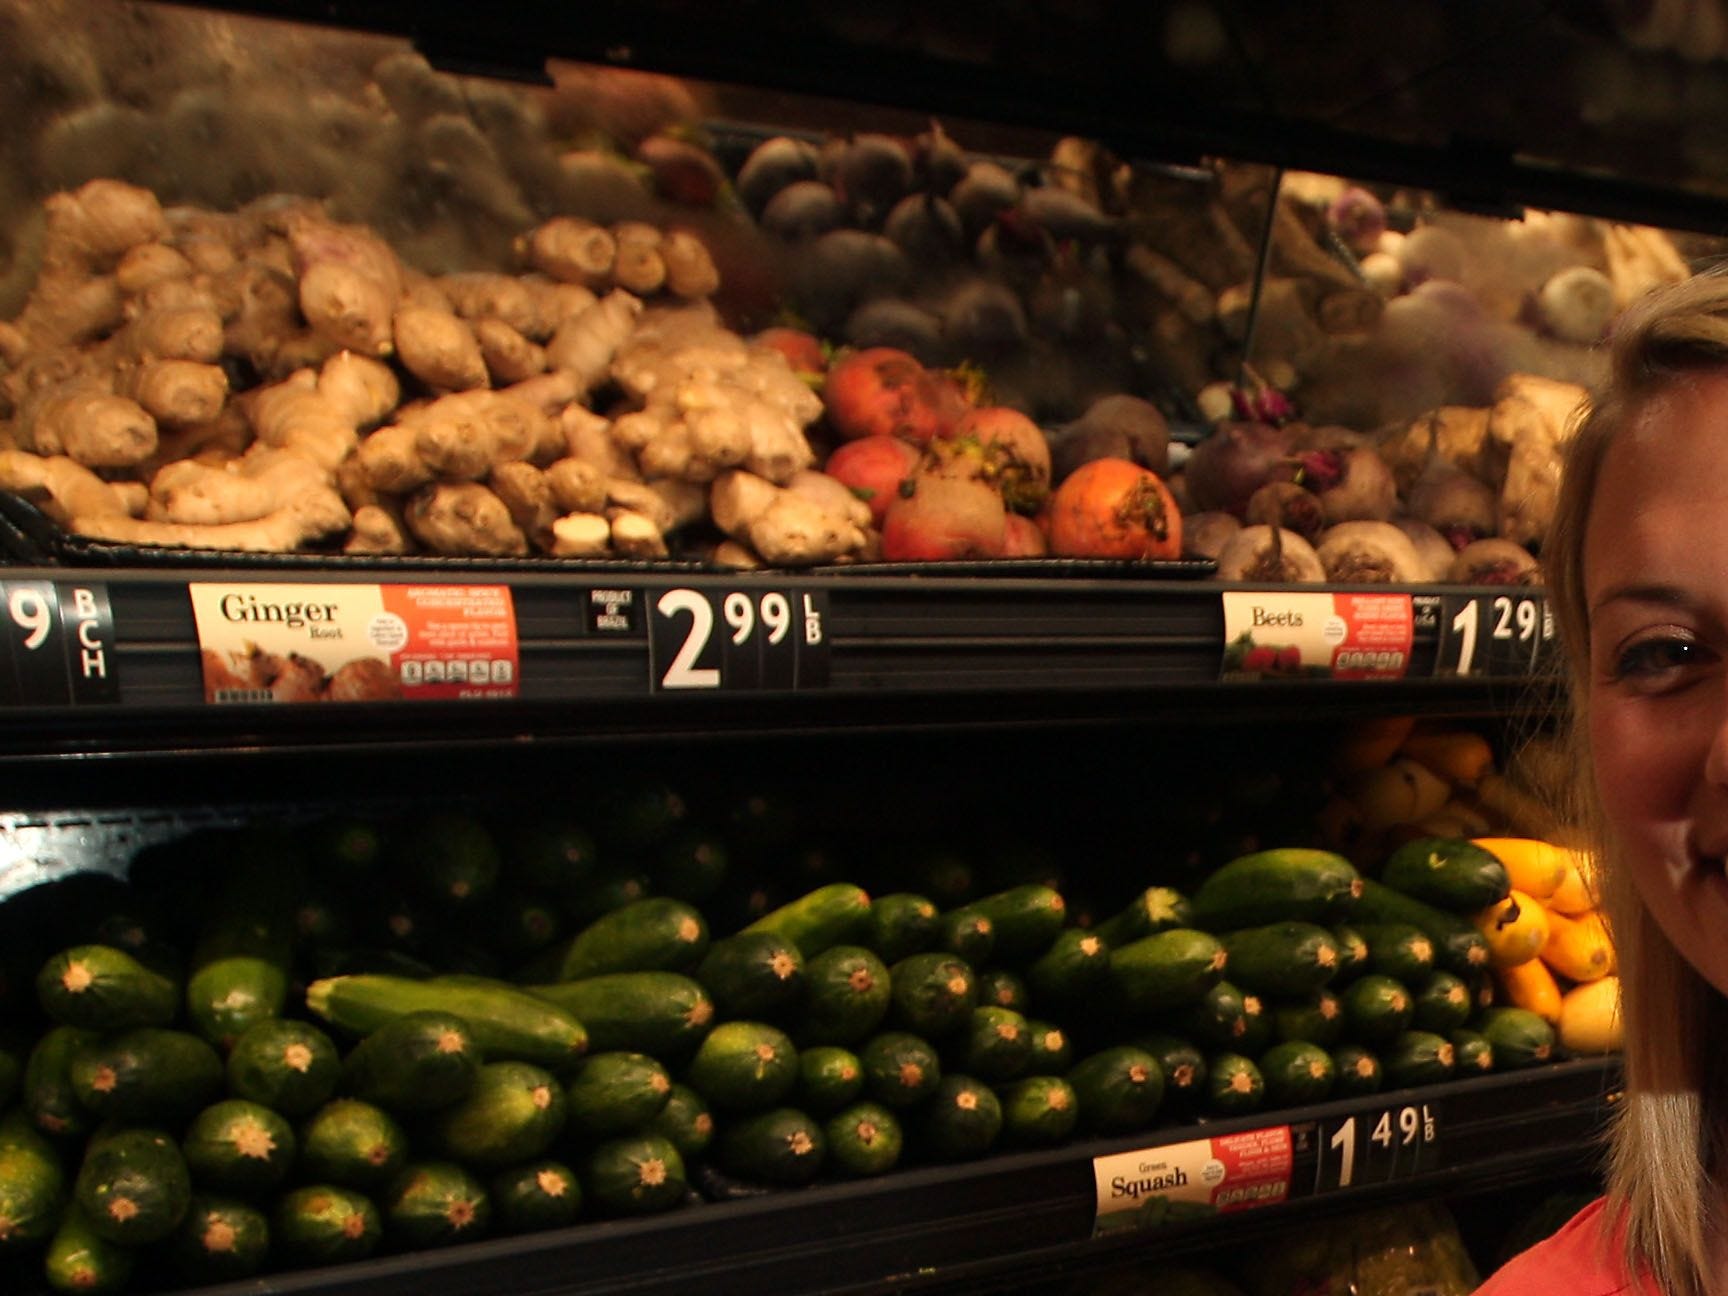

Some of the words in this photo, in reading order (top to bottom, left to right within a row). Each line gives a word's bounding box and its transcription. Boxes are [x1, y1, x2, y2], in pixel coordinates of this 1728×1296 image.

[592, 590, 632, 603] PRODUCT
[220, 593, 338, 626] Ginger
[606, 602, 621, 615] OF
[1251, 606, 1303, 628] Beets
[9, 588, 51, 649] 9
[597, 615, 629, 630] BRAZIL
[309, 626, 343, 640] Root
[1111, 1167, 1188, 1199] Squash
